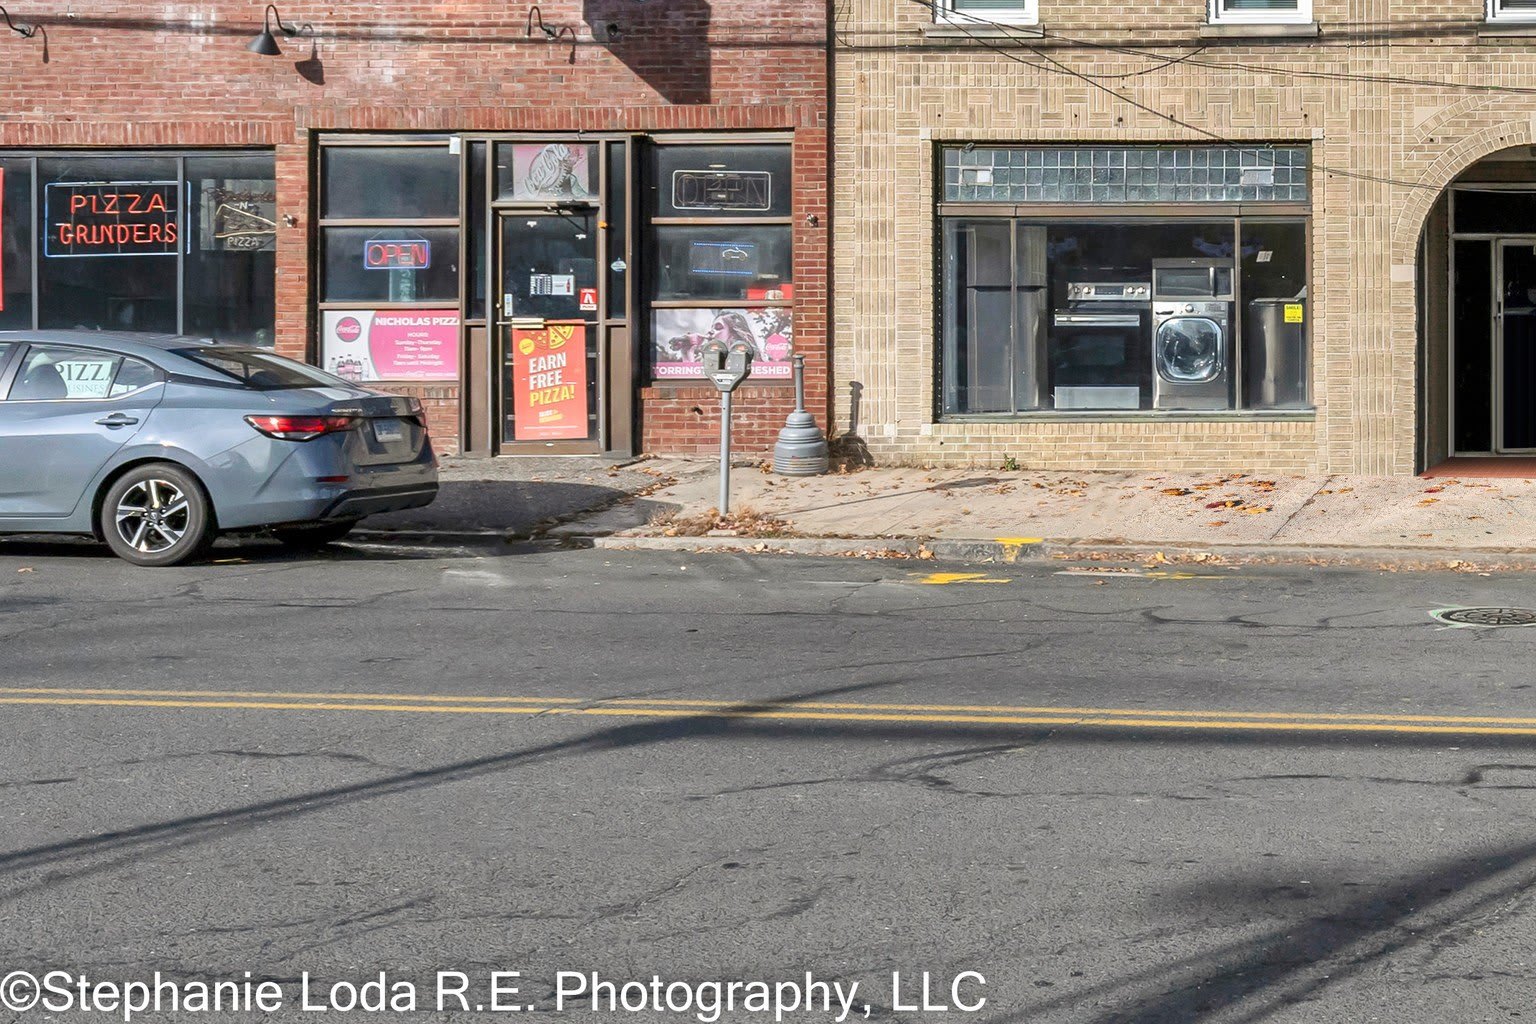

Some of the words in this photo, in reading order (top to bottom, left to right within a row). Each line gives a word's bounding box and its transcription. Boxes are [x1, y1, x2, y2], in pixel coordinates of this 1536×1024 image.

[70, 193, 166, 214] PIZZA
[59, 223, 177, 244] GRINDERS
[227, 236, 259, 246] PIZZA
[367, 244, 426, 265] OPEN
[375, 317, 431, 326] NICHOLAS
[529, 352, 567, 374] EARN
[529, 370, 563, 390] FREE
[529, 384, 575, 408] PIZZA!
